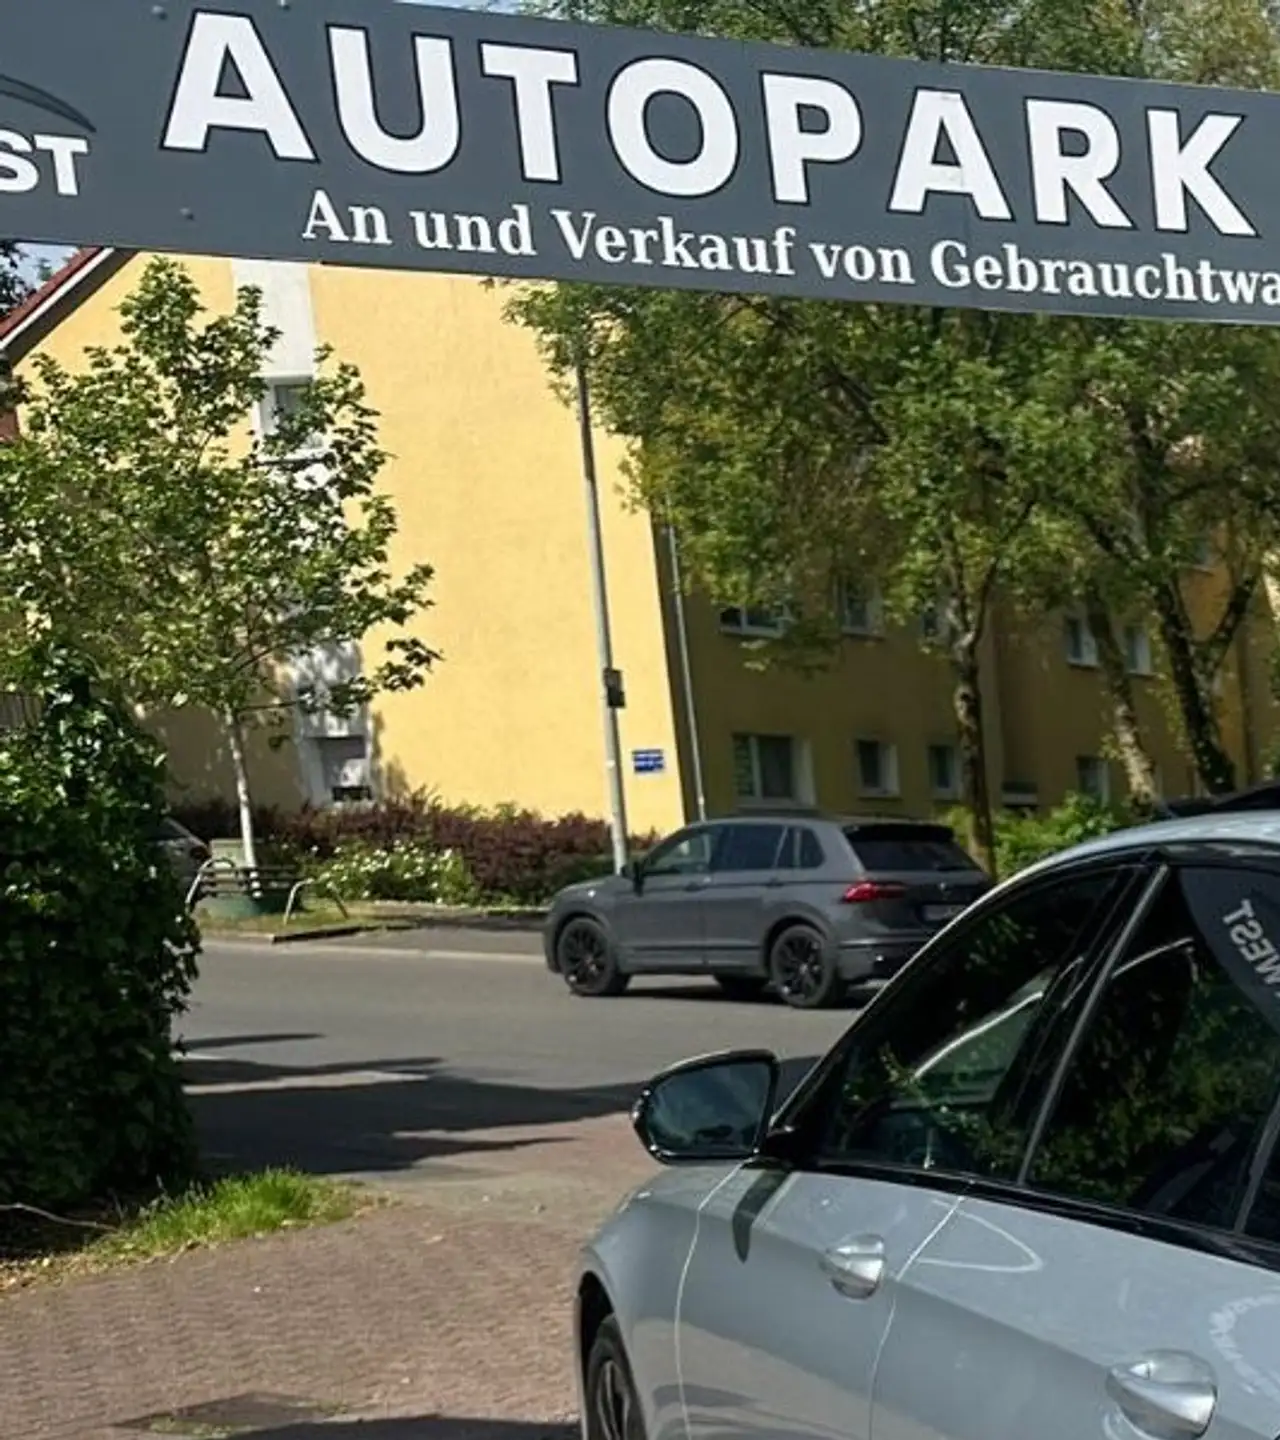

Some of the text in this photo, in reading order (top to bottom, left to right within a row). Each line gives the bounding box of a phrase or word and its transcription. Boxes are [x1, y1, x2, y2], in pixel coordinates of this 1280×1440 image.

[163, 11, 1256, 236] AUTOPARK
[302, 190, 392, 245] An
[409, 204, 537, 256] und
[550, 210, 796, 275] Verkauf
[809, 243, 915, 285] von
